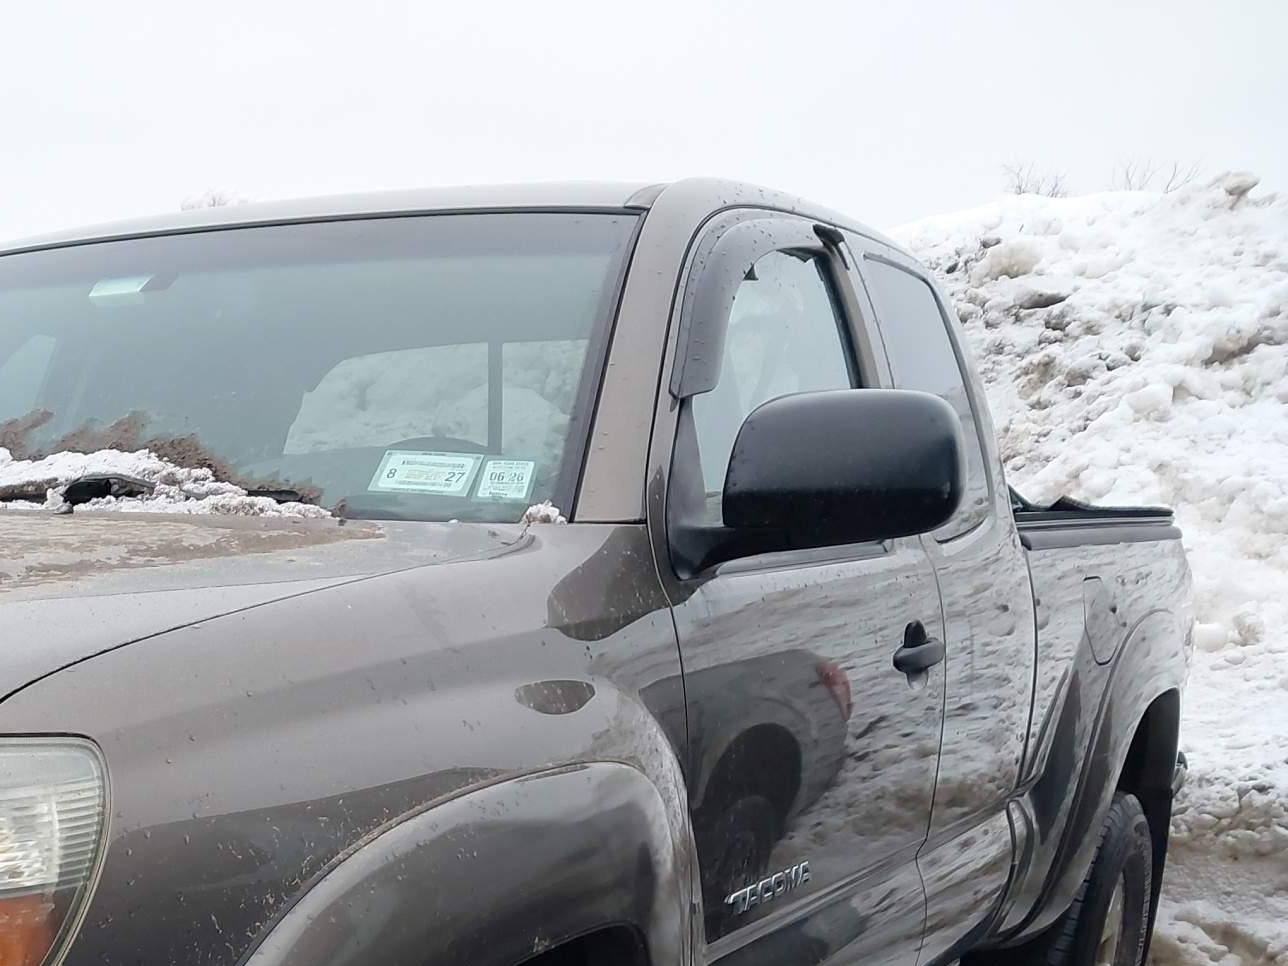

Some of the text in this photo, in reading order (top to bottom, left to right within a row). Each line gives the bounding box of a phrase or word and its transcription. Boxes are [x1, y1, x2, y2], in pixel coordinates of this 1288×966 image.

[386, 468, 466, 483] 8 27
[489, 471, 525, 481] 06 26
[724, 860, 810, 914] TACOMA
